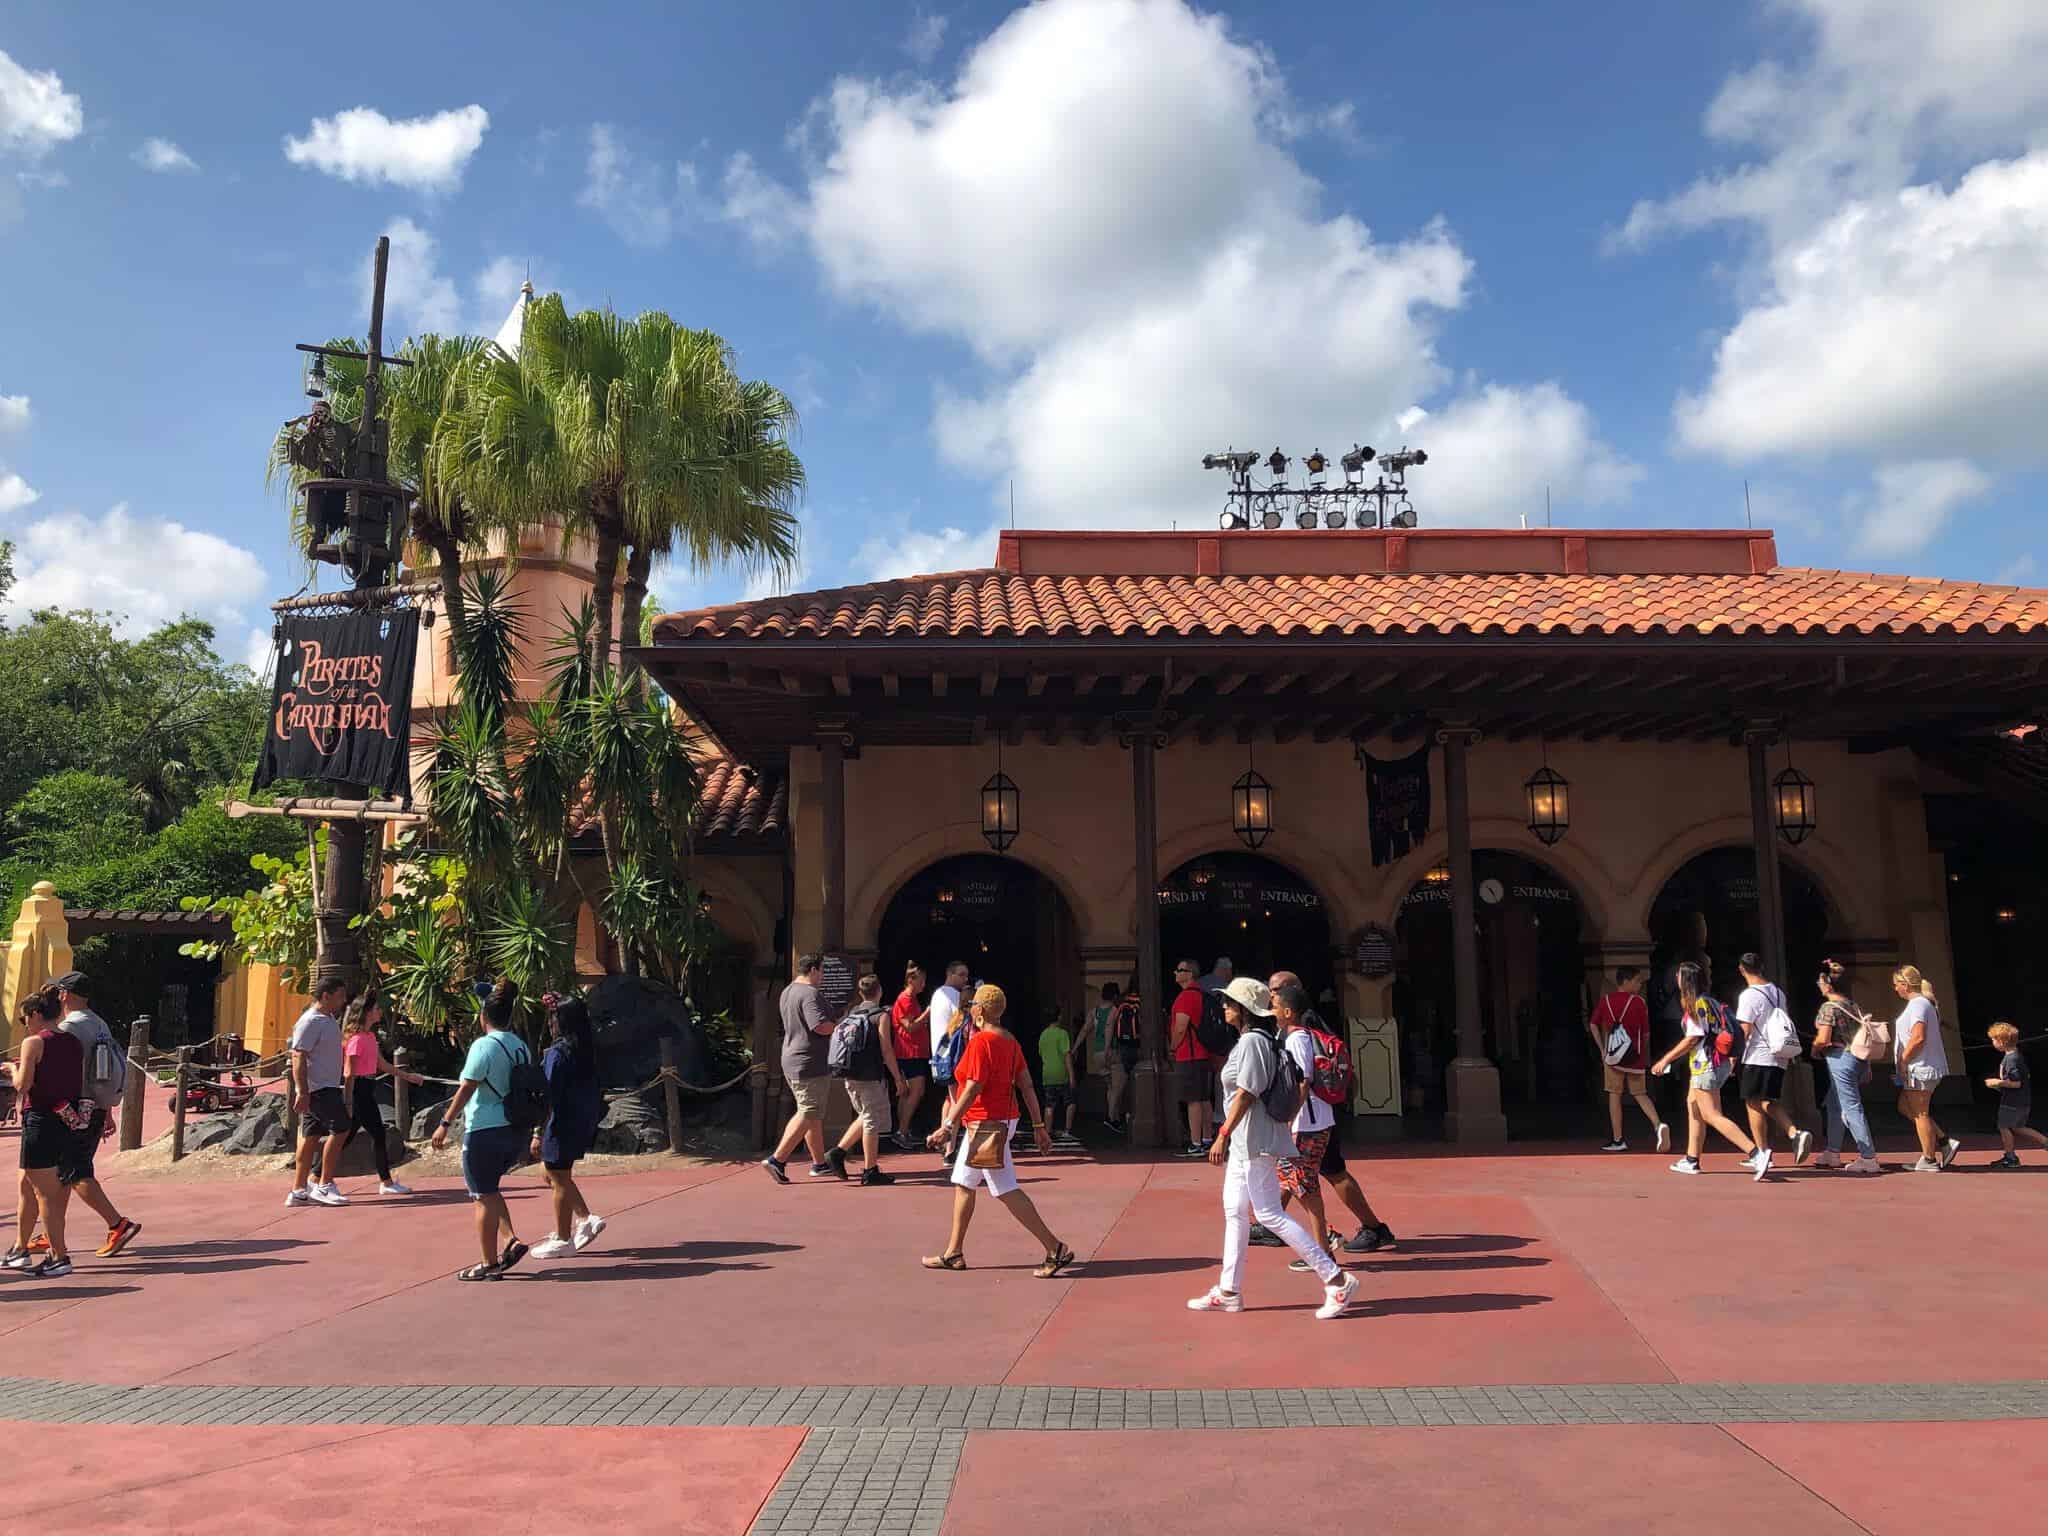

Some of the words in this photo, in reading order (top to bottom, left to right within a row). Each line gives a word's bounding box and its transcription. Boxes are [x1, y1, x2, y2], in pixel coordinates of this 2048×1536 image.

[299, 639, 383, 695] PIRATES
[330, 684, 349, 702] of
[1156, 890, 1189, 905] TAND
[1260, 888, 1321, 906] ENTRANCE
[1401, 888, 1450, 905] FASTPAS
[1513, 886, 1573, 900] ENTRANCE
